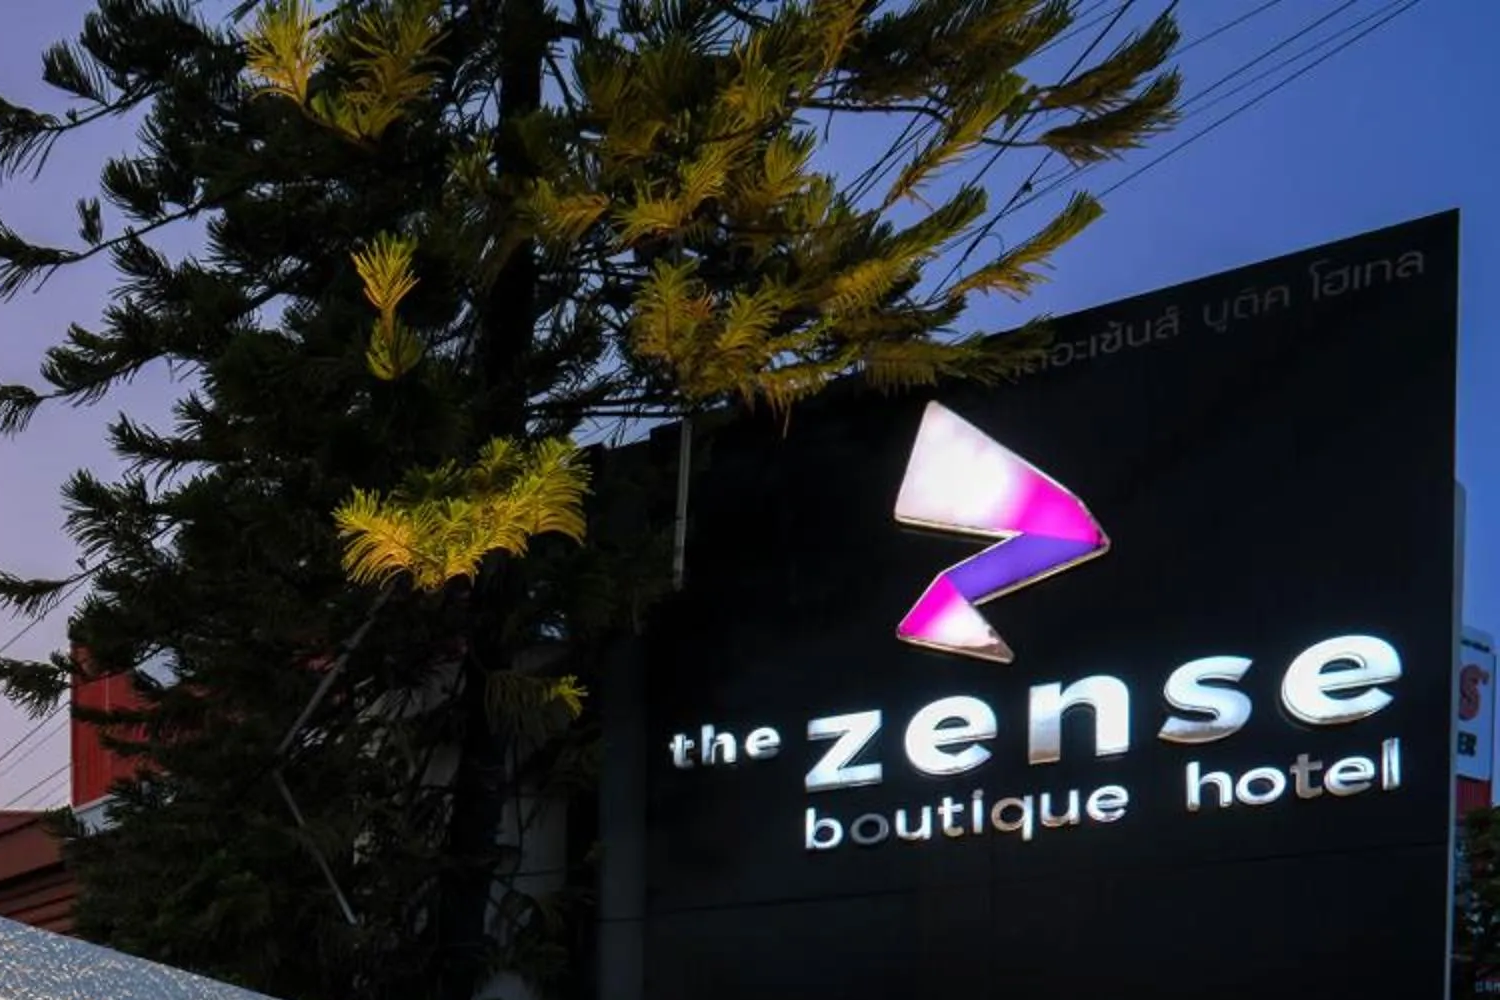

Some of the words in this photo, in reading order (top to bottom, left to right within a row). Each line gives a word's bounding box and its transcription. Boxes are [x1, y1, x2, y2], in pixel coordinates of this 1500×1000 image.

[669, 724, 781, 769] the
[804, 634, 1403, 792] zense
[804, 784, 1129, 850] boutique
[1185, 738, 1402, 811] hotel
